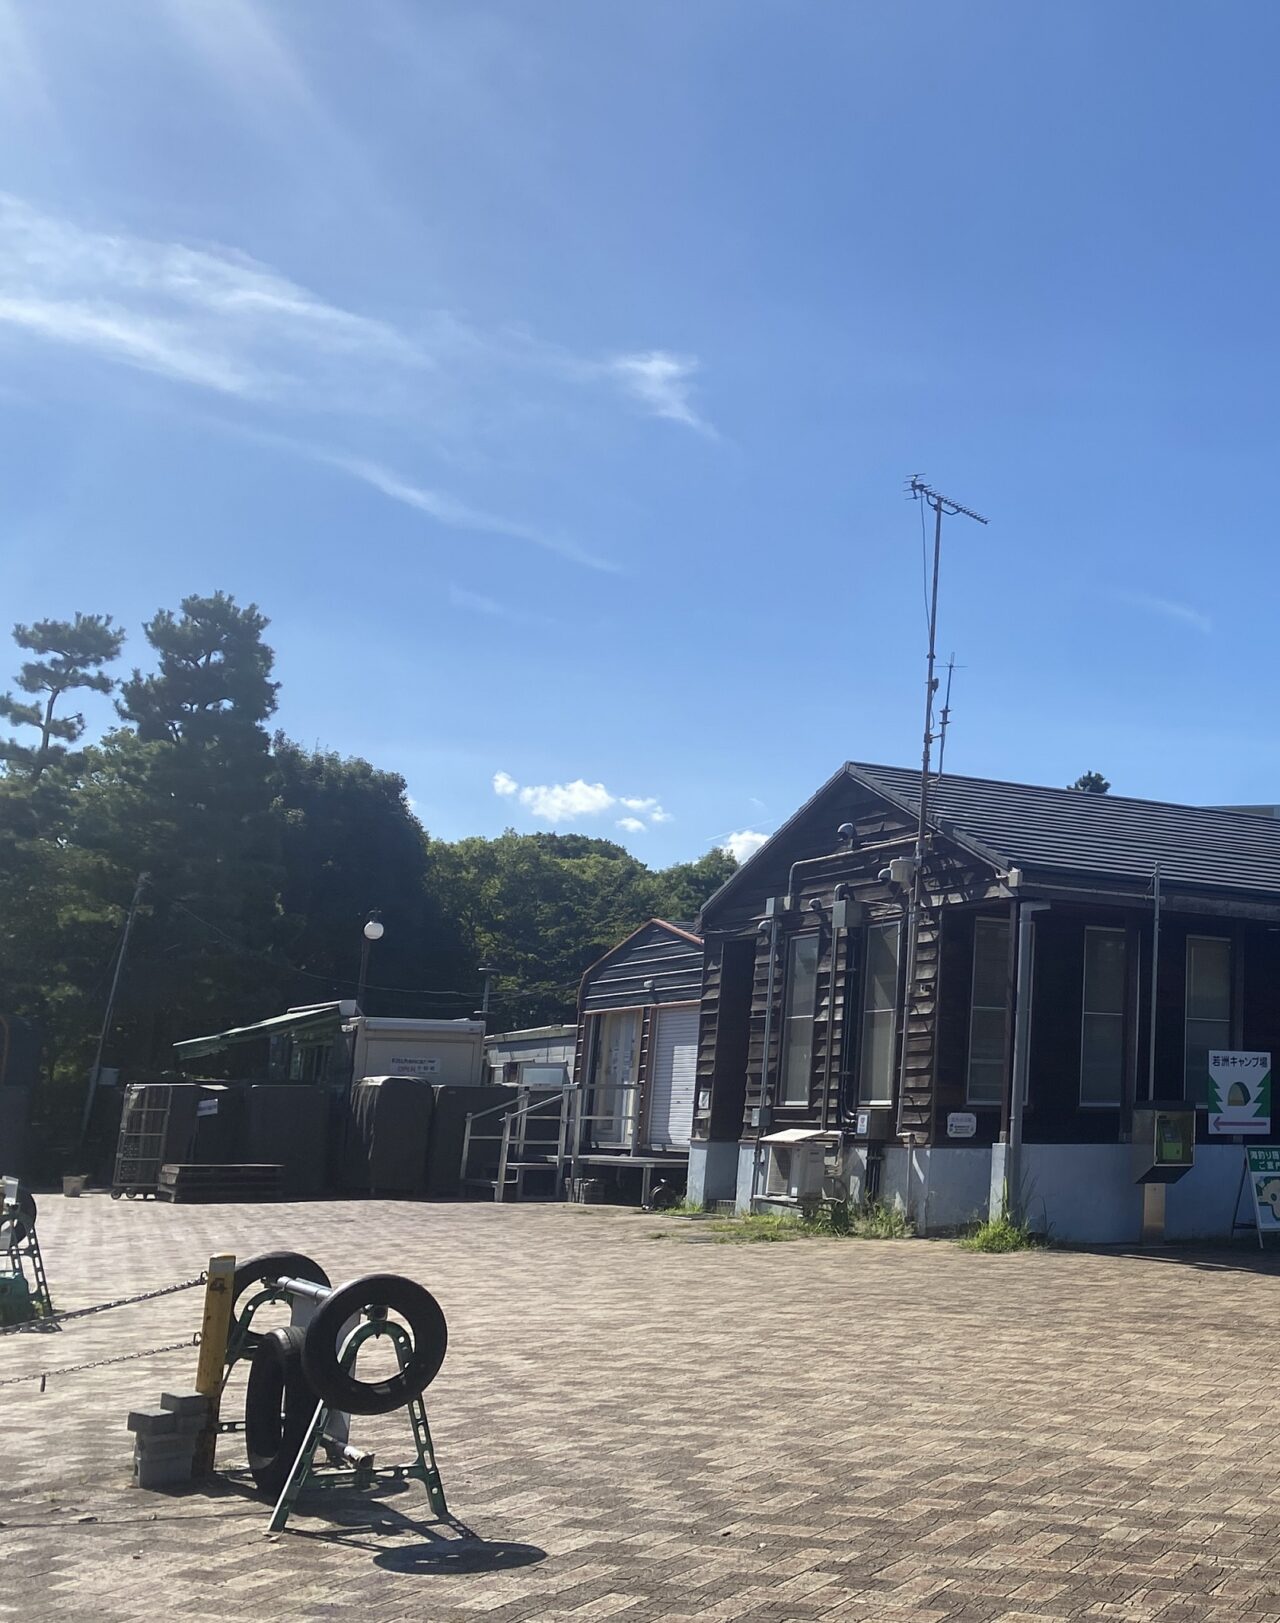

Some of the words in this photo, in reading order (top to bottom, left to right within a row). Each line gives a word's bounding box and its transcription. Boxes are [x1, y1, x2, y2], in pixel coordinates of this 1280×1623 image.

[1212, 1055, 1268, 1068] 若洲キャンプ場
